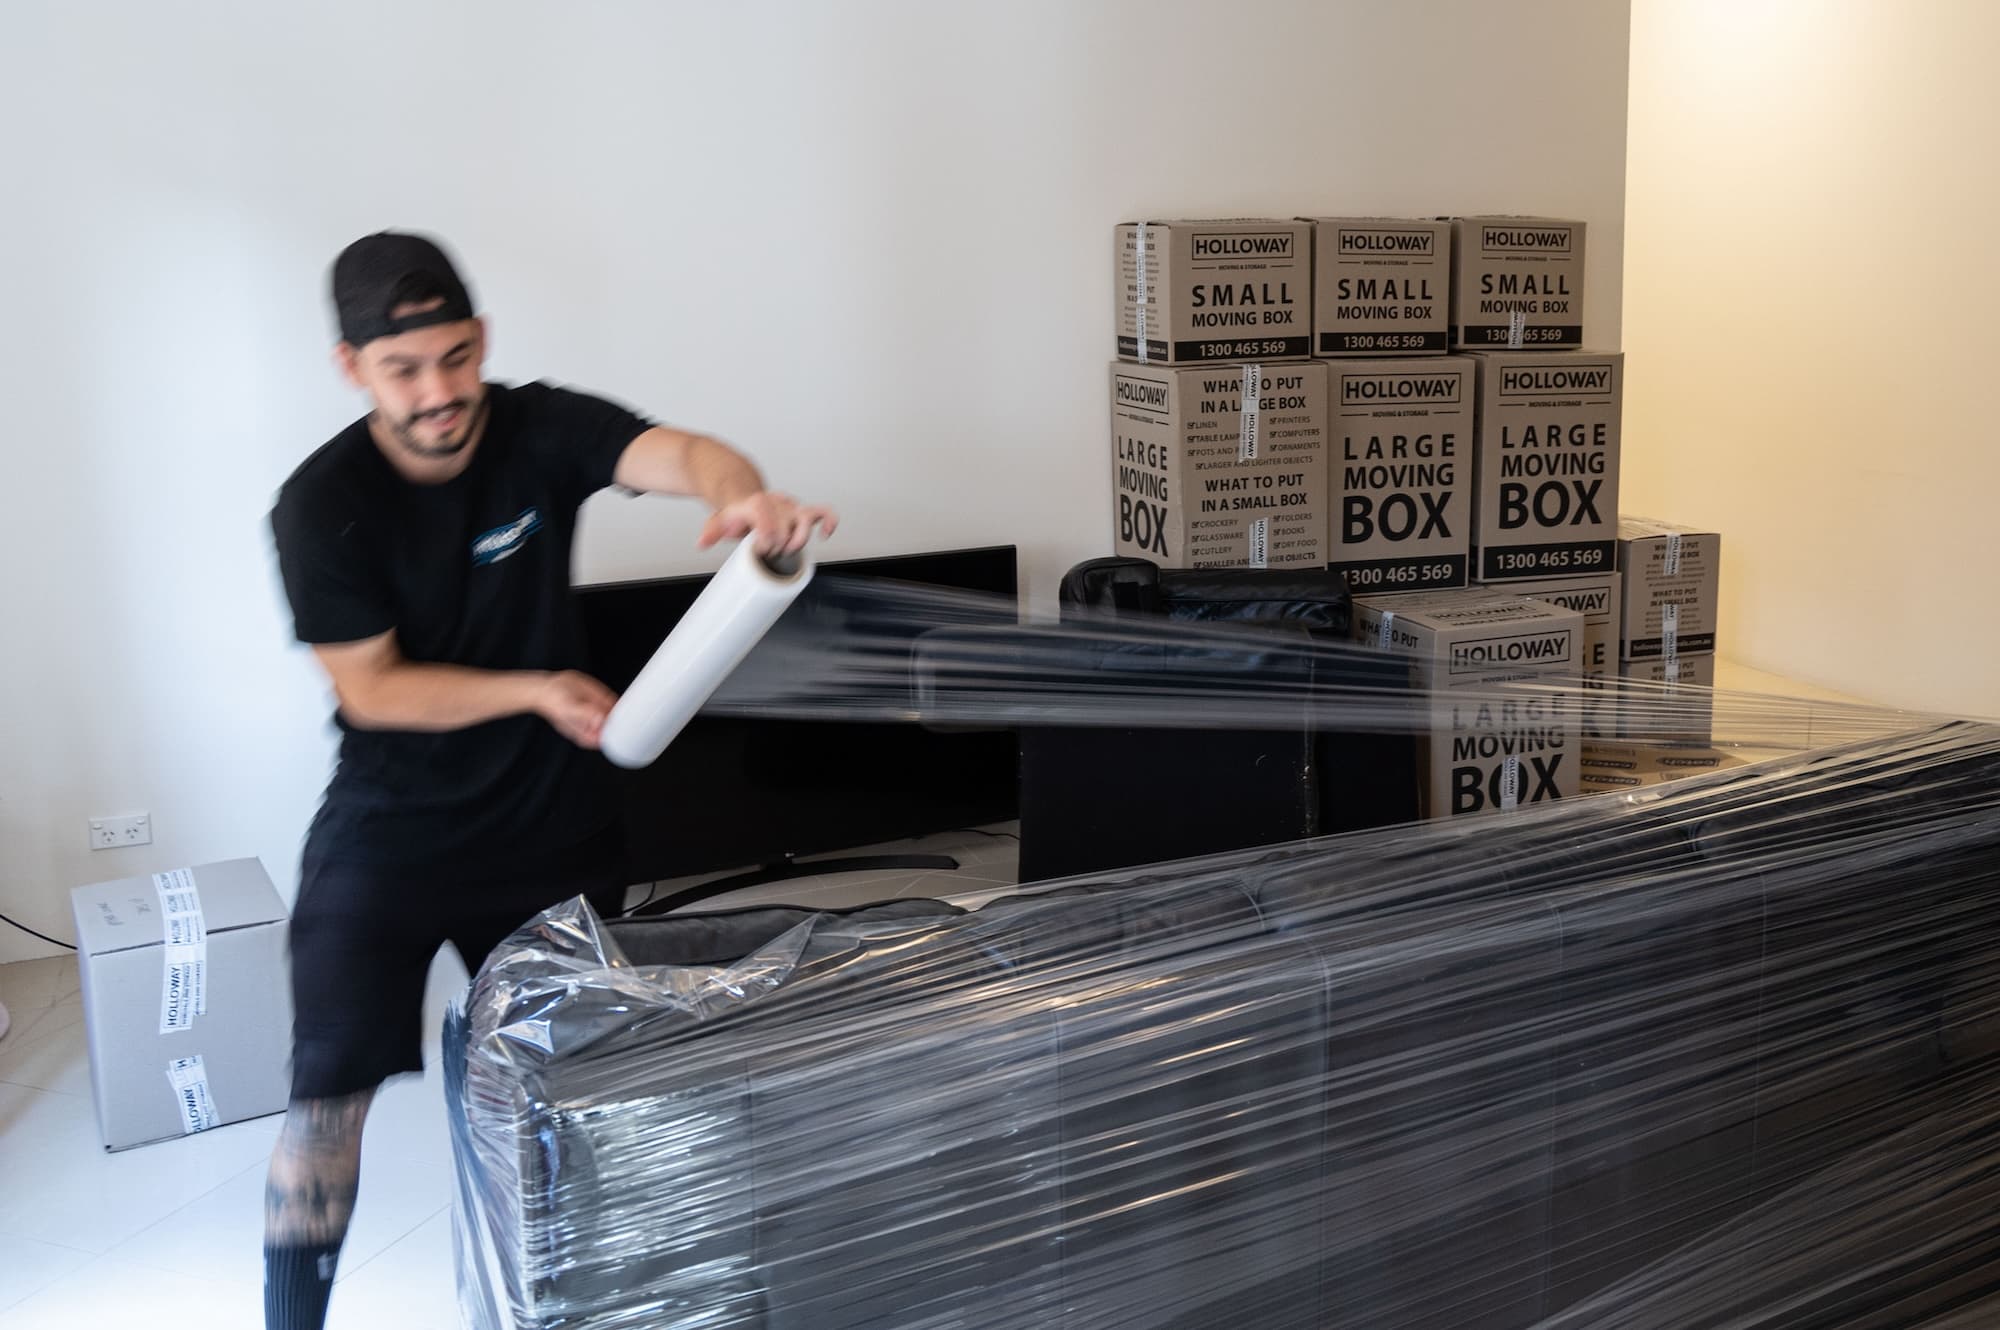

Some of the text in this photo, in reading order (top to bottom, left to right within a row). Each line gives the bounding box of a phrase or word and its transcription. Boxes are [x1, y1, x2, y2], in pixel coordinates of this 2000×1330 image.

[1195, 238, 1289, 254] HOLLOWAY
[1342, 235, 1430, 251] HOLLOWAY
[1485, 232, 1568, 247] HOLLOWAY
[1338, 278, 1432, 300] SMALL
[1481, 274, 1570, 295] SMALL
[1192, 283, 1293, 307] SMALL
[1337, 306, 1432, 320] MOVING BOX
[1480, 300, 1569, 313] MOVING BOX
[1192, 310, 1293, 327] MOVING BOX
[1344, 335, 1424, 348] 1300 465 569
[1486, 329, 1509, 341] 130
[1541, 329, 1562, 341] 569
[1200, 341, 1286, 356] 1300 465 569
[1250, 363, 1258, 398] OLLOWAY
[1277, 377, 1303, 390] PUT
[1345, 379, 1456, 399] HOLLOWAY
[1504, 371, 1608, 390] HOLLOWAY
[1117, 382, 1167, 406] HOLLOWAY
[1201, 396, 1306, 413] IN A LGE BOX
[1195, 421, 1217, 429] LINEN
[1277, 416, 1311, 424] PRINTERS
[1195, 433, 1240, 443] TABLE LAMP
[1277, 428, 1320, 438] COMPUTERS
[1502, 423, 1606, 449] LARGE
[1118, 435, 1168, 471] LARGE
[1196, 449, 1215, 457] POTS
[1217, 447, 1233, 456] AND
[1278, 442, 1320, 451] ORNAMENTS
[1344, 434, 1455, 460] LARGE
[1203, 456, 1313, 470] LARGER AND LIGHTER OBJECTS
[1501, 452, 1605, 478] MOVING
[1120, 465, 1168, 502] MOVING
[1205, 474, 1304, 492] WHAT TO PUT
[1344, 463, 1454, 490] MOVING
[1202, 493, 1307, 512] IN A SMALL BOX
[1499, 479, 1603, 530] BOX
[1120, 493, 1169, 558] BOX
[1200, 520, 1238, 529] CROCKERY
[1280, 513, 1312, 522] FOLDERS
[1342, 491, 1453, 544] BOX
[1200, 532, 1244, 542] GLASSWARE
[1281, 527, 1305, 535] BOOKS
[1200, 547, 1232, 555] CUTLERY
[1281, 539, 1317, 548] DRY FOOD
[1202, 560, 1235, 569] SMALLER
[1285, 552, 1316, 562] OBJECTS
[1497, 549, 1602, 570] 1300 465 569
[1341, 564, 1452, 585] 1300 465 569
[1360, 621, 1381, 635] WHA
[1401, 632, 1419, 649] PUT
[1454, 636, 1566, 667] HOLLOWAY
[1452, 694, 1566, 732] LARGE
[1452, 724, 1566, 762] MOVING
[1452, 753, 1563, 816] BOX
[168, 967, 180, 1026] HOLLOWAY
[184, 1089, 201, 1132] OLLOWAY
